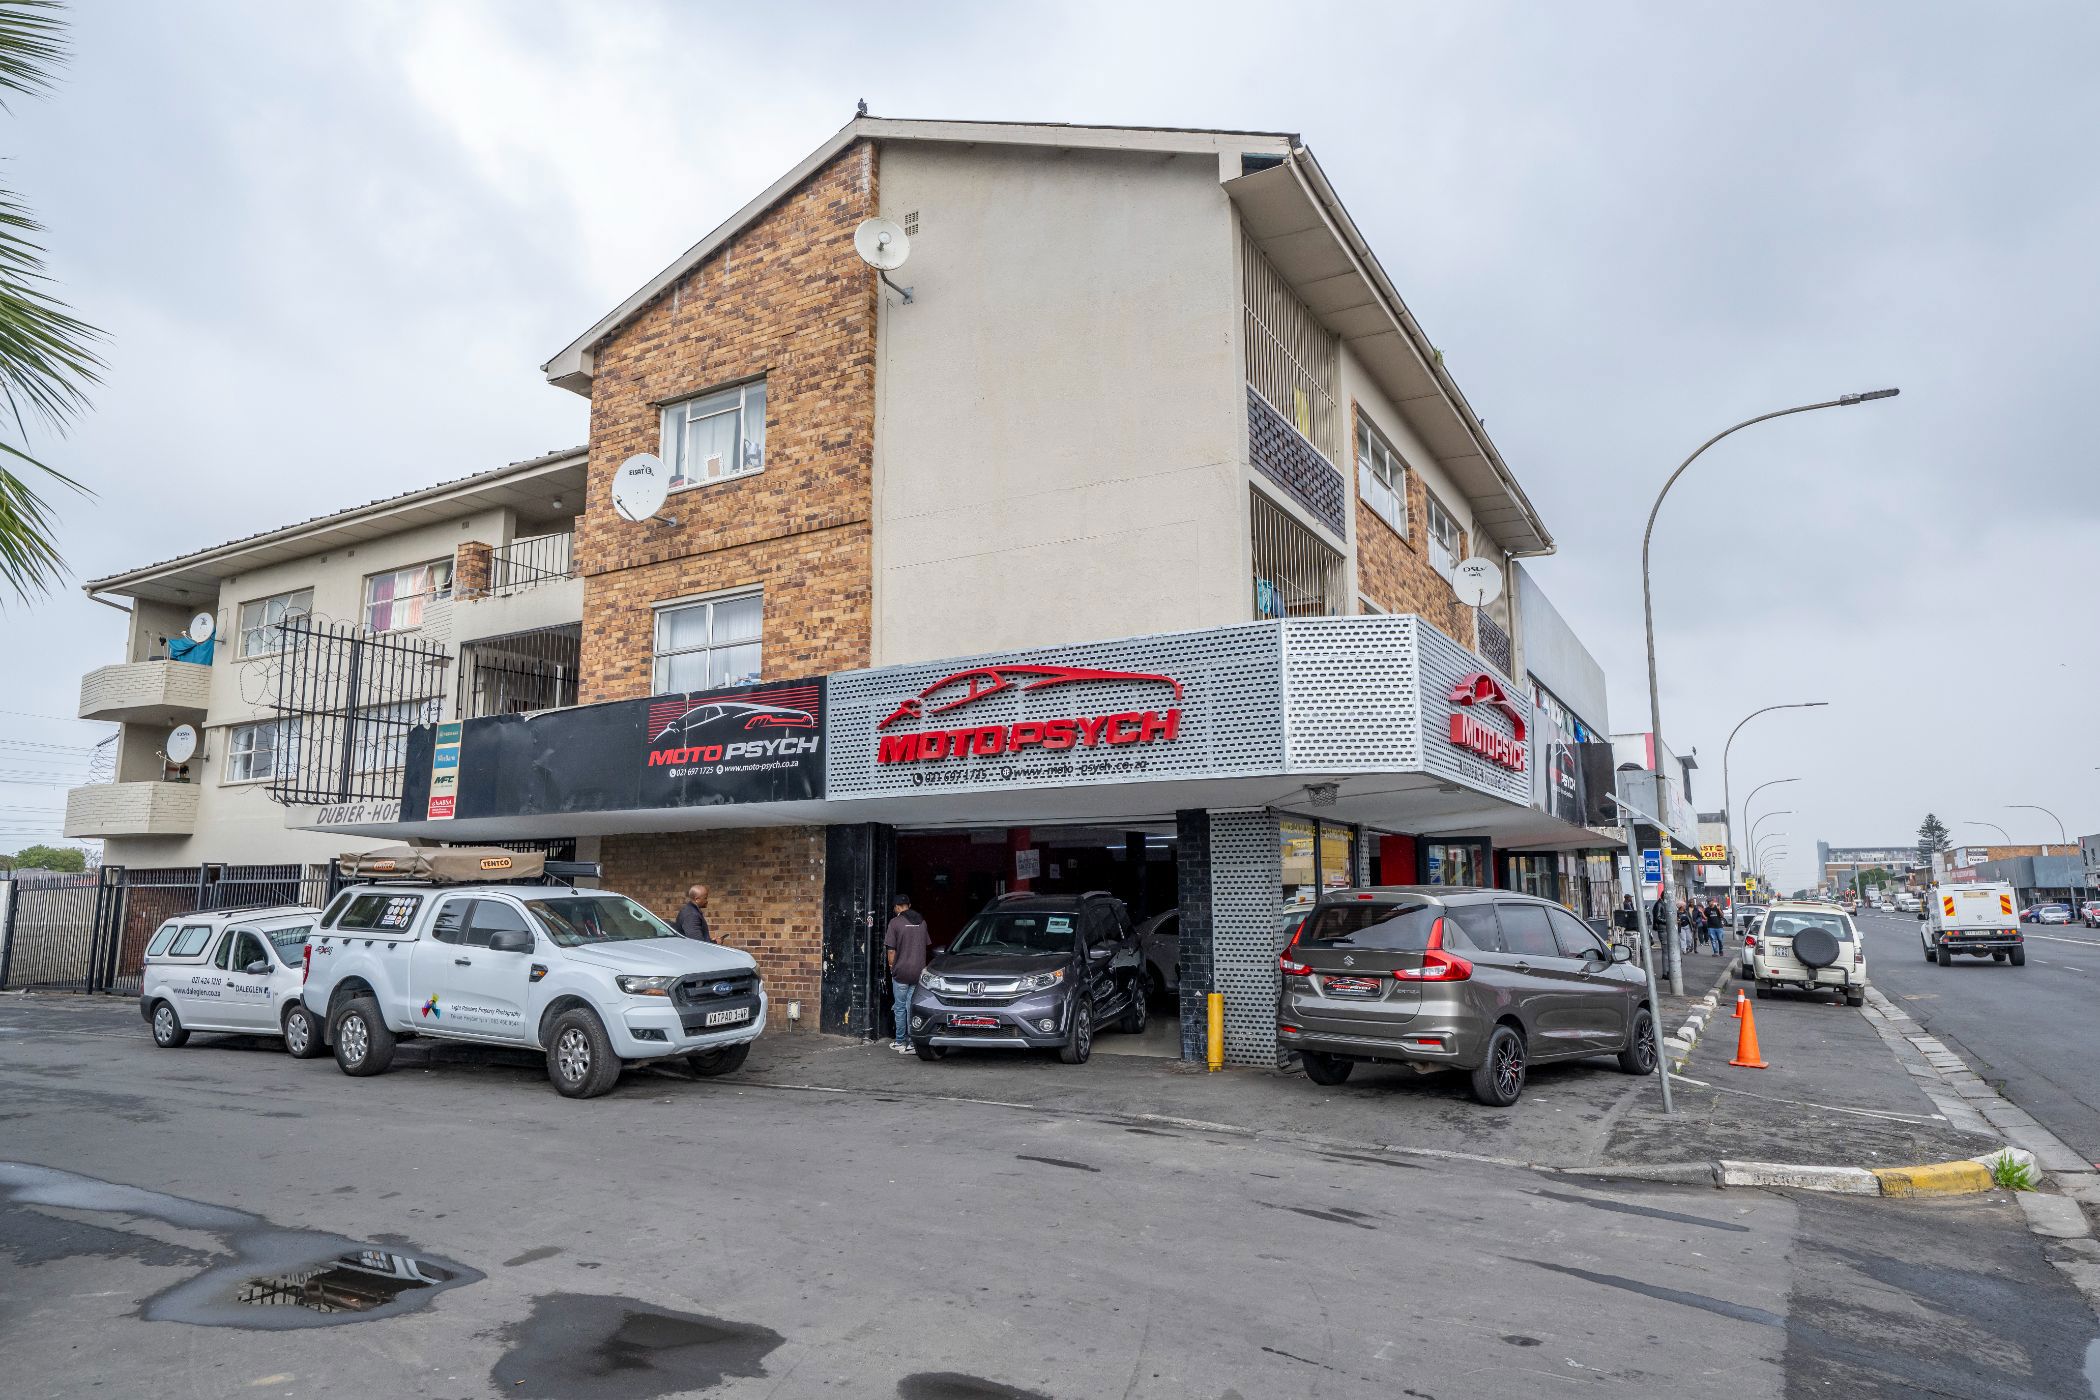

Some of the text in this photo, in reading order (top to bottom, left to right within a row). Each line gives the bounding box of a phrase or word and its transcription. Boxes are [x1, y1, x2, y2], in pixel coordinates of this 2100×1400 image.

[724, 736, 819, 760] PSYCH
[724, 760, 799, 773] www.moto-psych.co.za
[434, 776, 455, 784] MFC
[483, 859, 510, 867] TENTCO
[235, 985, 263, 994] DALEGLEN
